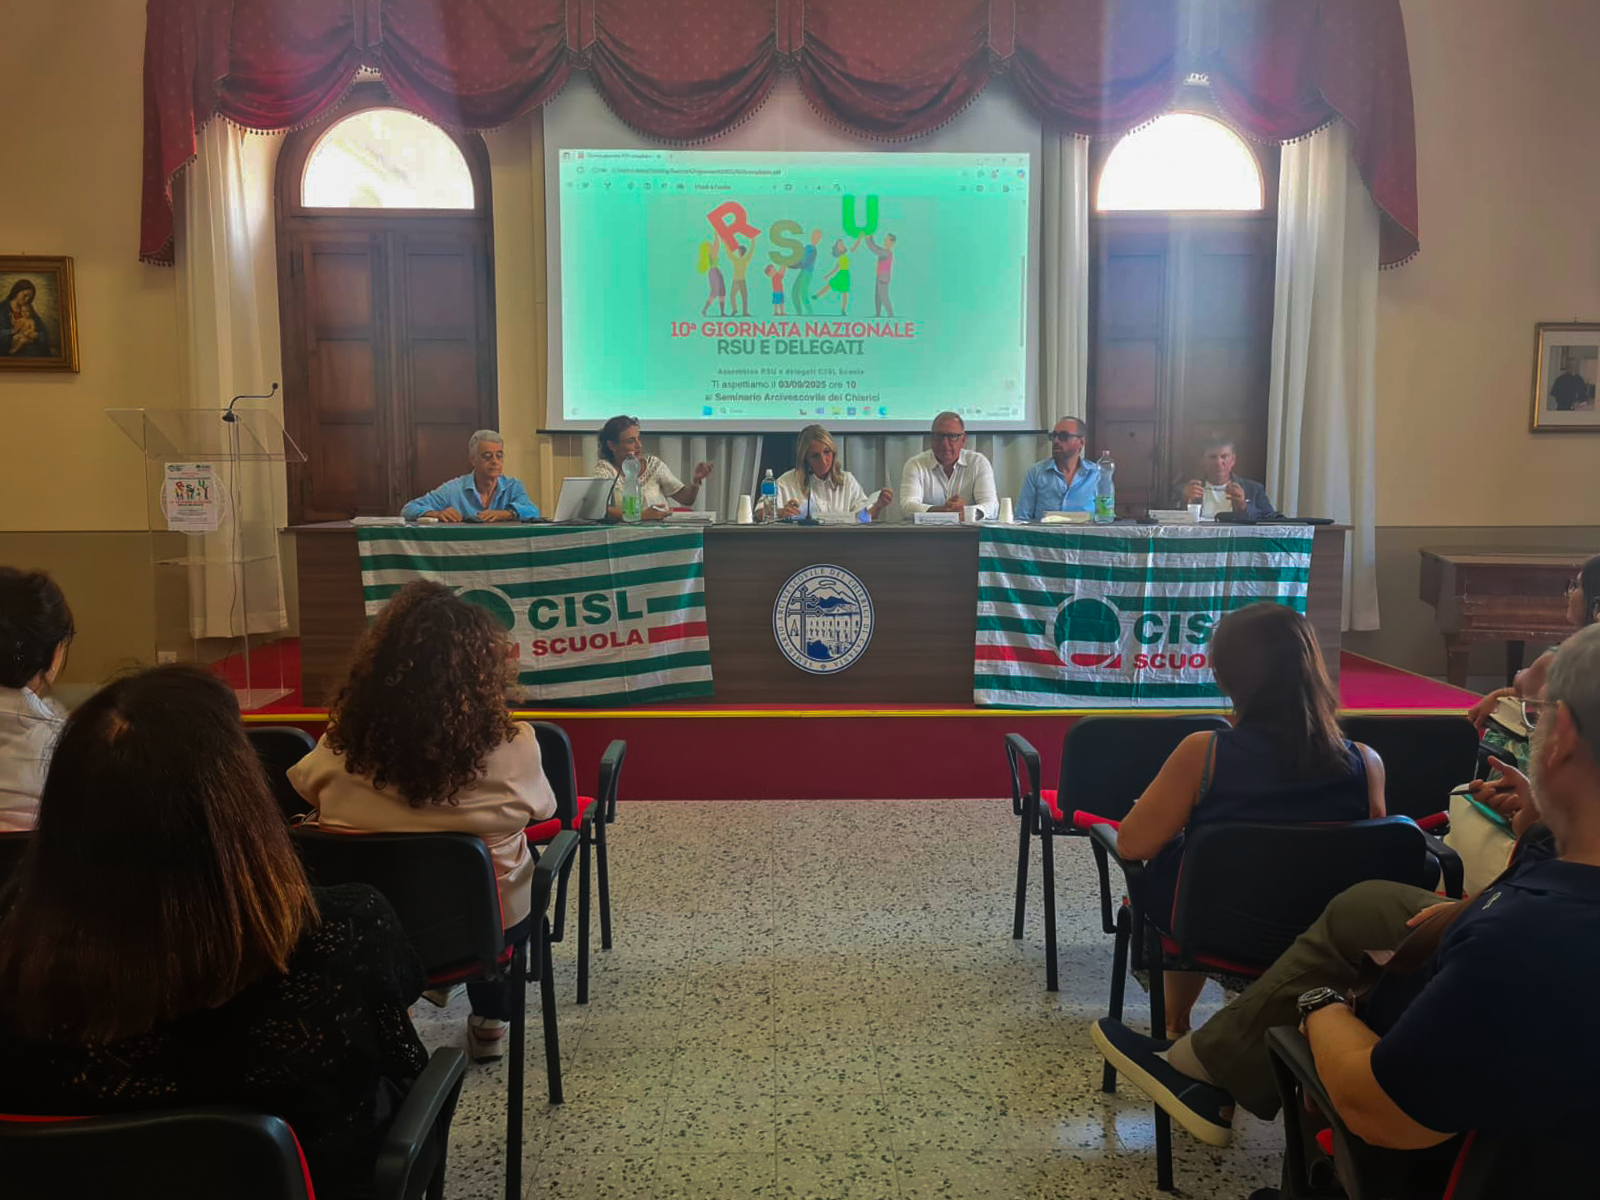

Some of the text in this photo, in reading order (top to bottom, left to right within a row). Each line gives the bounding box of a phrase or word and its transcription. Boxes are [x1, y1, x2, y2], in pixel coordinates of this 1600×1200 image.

[701, 321, 800, 338] GIORNATA
[805, 322, 915, 338] NAZIONALE
[717, 339, 865, 355] RSU E DELEGATI
[761, 368, 777, 376] RSU
[785, 368, 816, 377] delegati
[818, 368, 837, 376] CISL
[712, 380, 719, 389] Ti
[721, 380, 769, 391] aspettiamo
[829, 381, 843, 389] ore
[846, 381, 857, 390] 10
[714, 393, 762, 401] Seminario
[764, 393, 826, 402] Arcivescovile
[828, 393, 842, 402] dei
[528, 590, 643, 631] CISL
[1133, 612, 1222, 645] CIS
[531, 628, 645, 657] SCUOLA
[1133, 653, 1213, 670] SCUO
